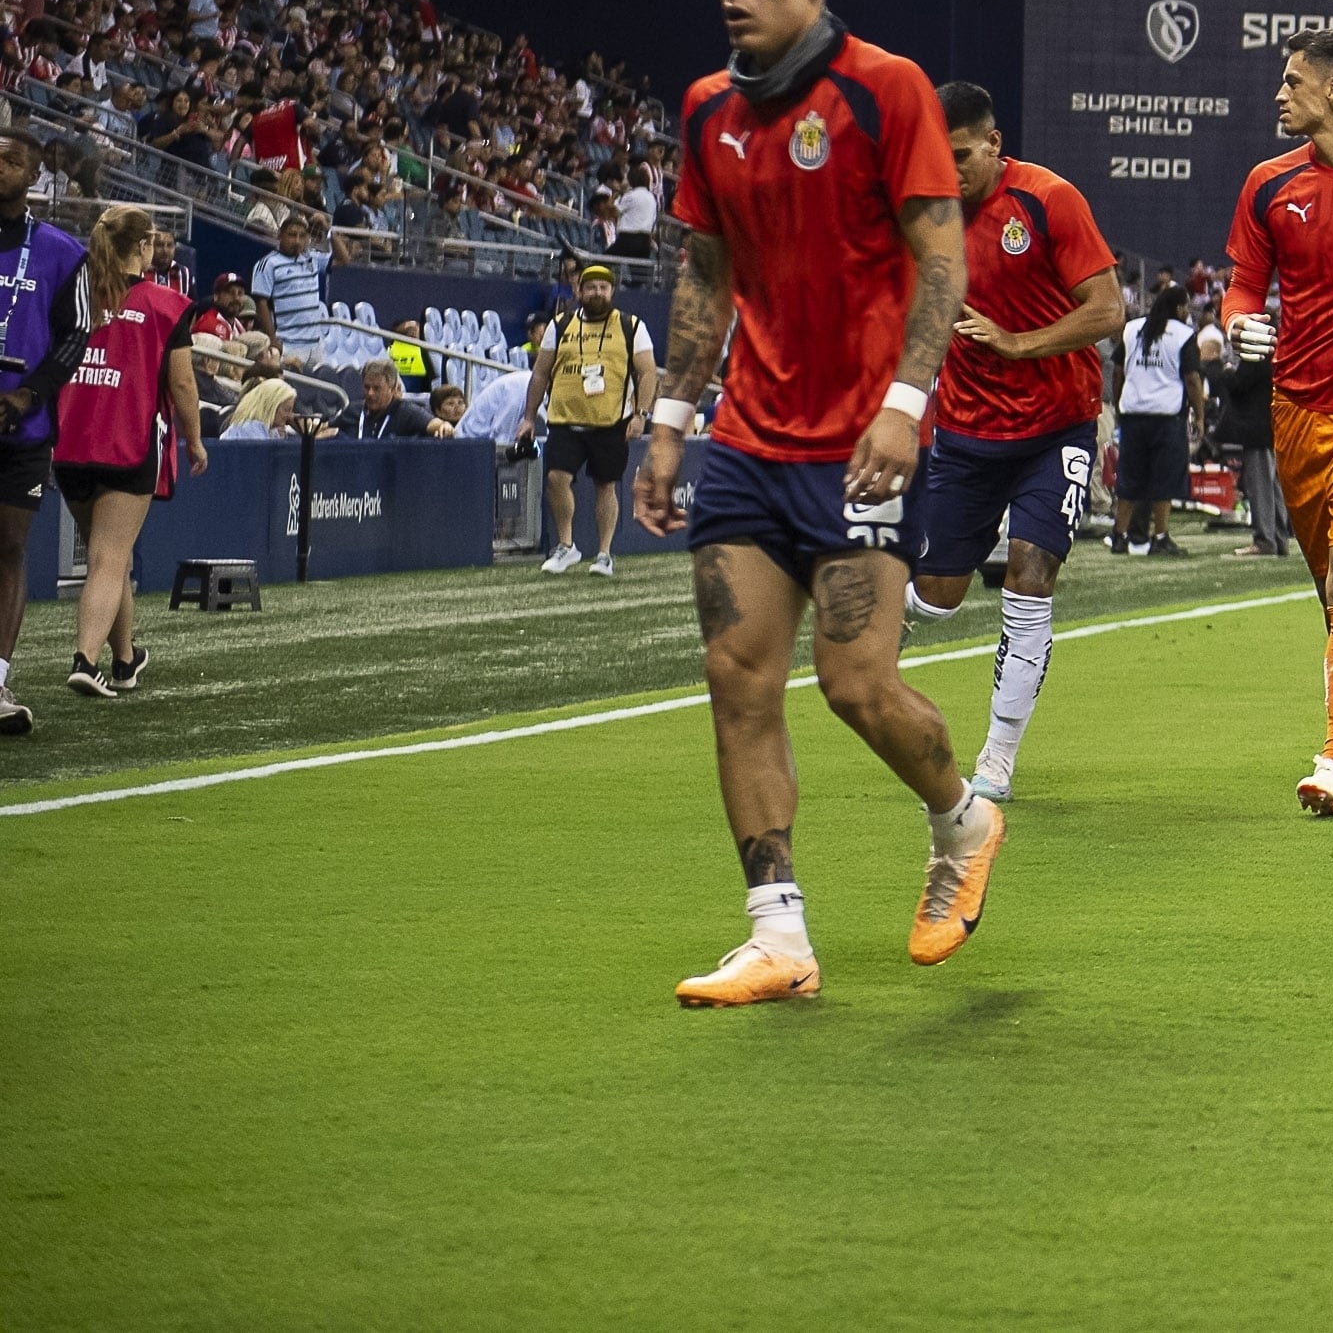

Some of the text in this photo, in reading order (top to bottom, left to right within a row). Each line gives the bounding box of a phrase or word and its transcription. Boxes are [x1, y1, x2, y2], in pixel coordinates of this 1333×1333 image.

[1071, 92, 1230, 117] SUPPORTERS
[1109, 115, 1193, 137] SHIELD
[1110, 156, 1192, 181] 2000
[340, 491, 363, 523] Mercy
[364, 489, 381, 518] Park
